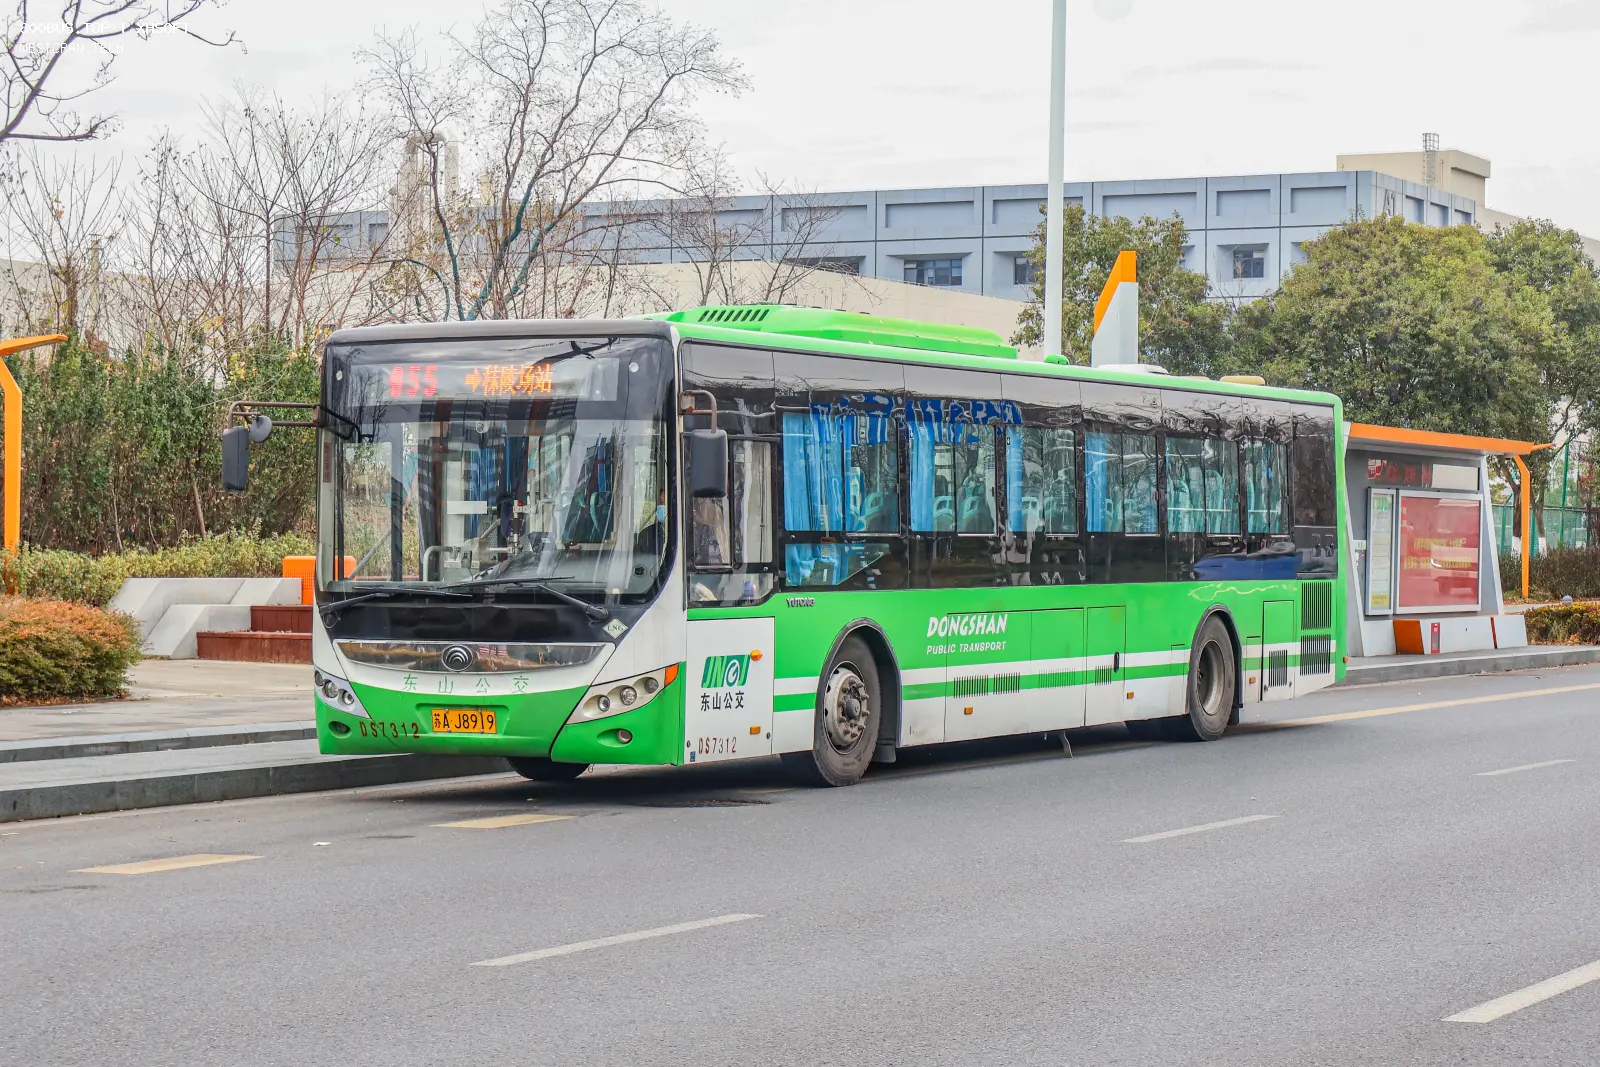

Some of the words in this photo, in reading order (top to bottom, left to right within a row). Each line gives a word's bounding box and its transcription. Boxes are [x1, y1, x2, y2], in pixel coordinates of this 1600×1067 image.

[389, 365, 438, 397] 055
[786, 597, 816, 608] YUTONG
[926, 613, 1008, 638] DONGSHAN
[926, 643, 956, 655] PUBLIC
[959, 641, 1007, 653] TRANSPORT
[402, 673, 530, 695] 东山公交
[700, 690, 745, 712] 东山公交
[359, 720, 420, 739] DS7312
[698, 736, 737, 754] DS7312
